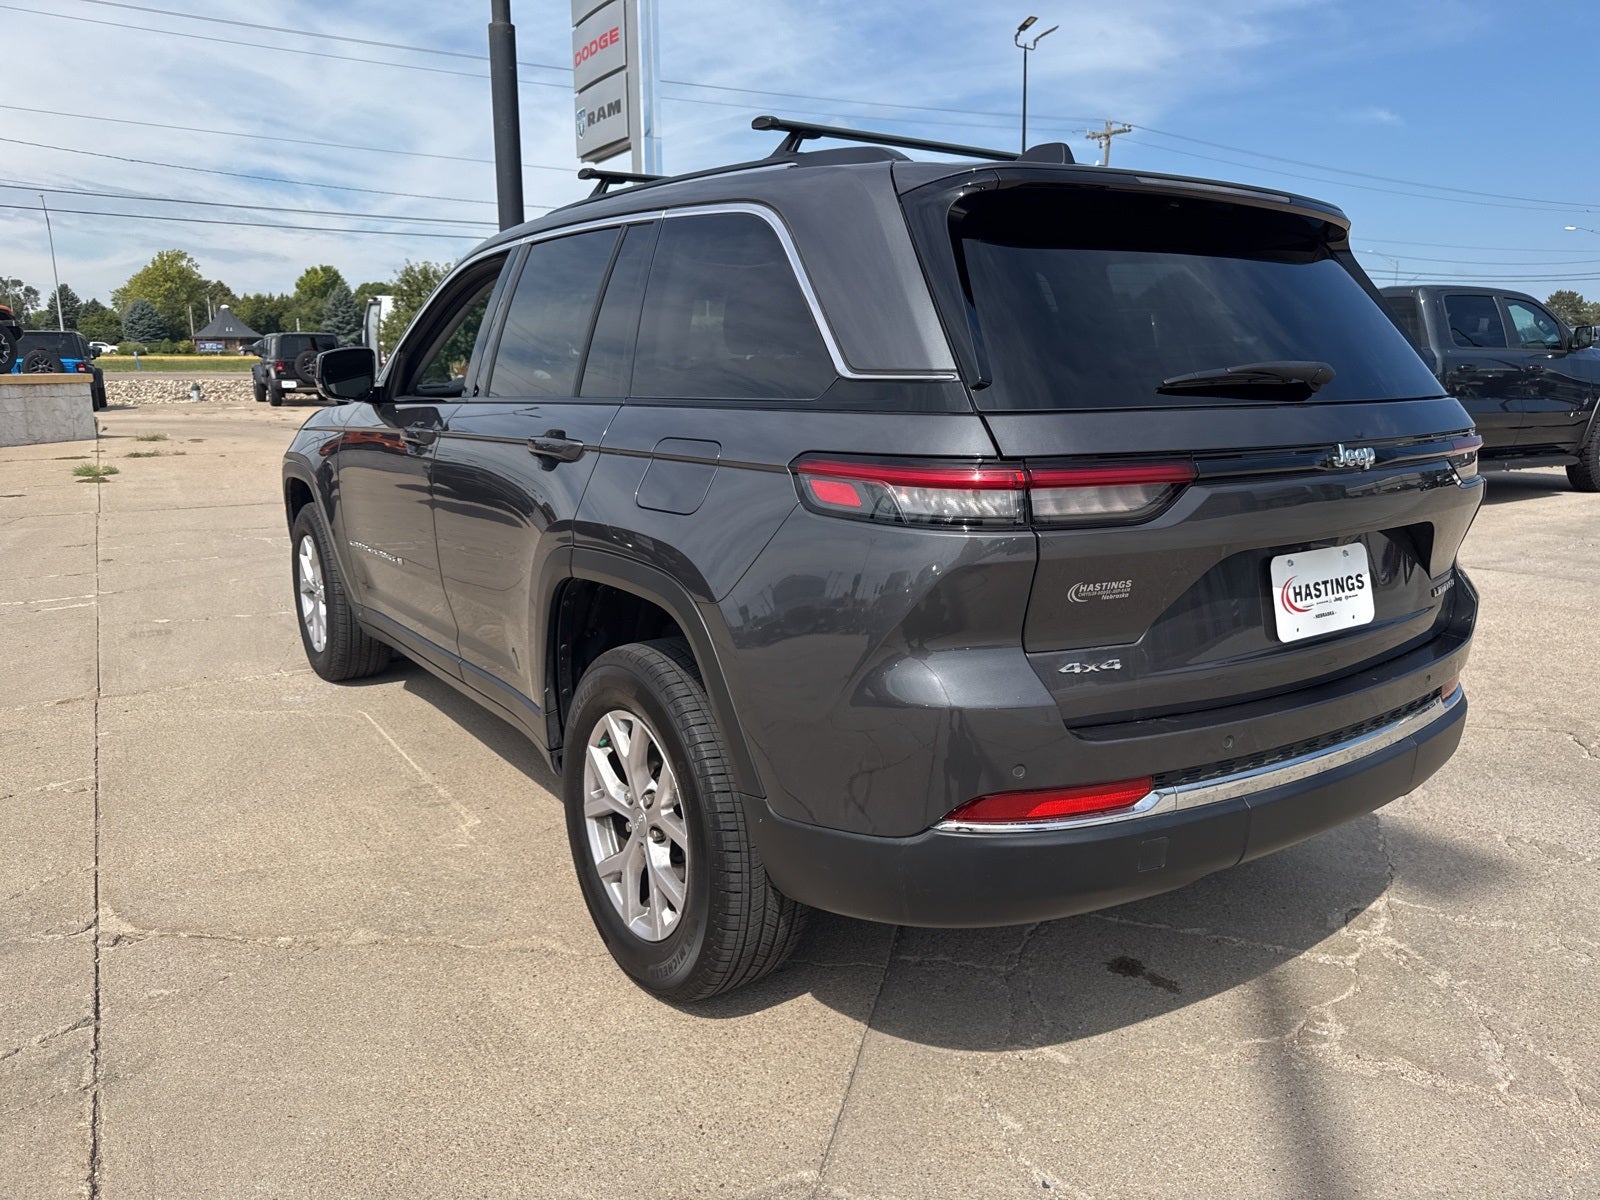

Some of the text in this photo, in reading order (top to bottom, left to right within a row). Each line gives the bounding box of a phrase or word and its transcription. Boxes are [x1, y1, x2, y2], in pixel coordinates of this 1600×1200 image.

[574, 27, 620, 67] DODGE
[587, 98, 622, 127] RAM
[1332, 443, 1376, 470] Jeep
[1079, 580, 1132, 592] HASTINGS
[1292, 573, 1365, 603] HASTINGS
[1058, 659, 1122, 674] 4x4
